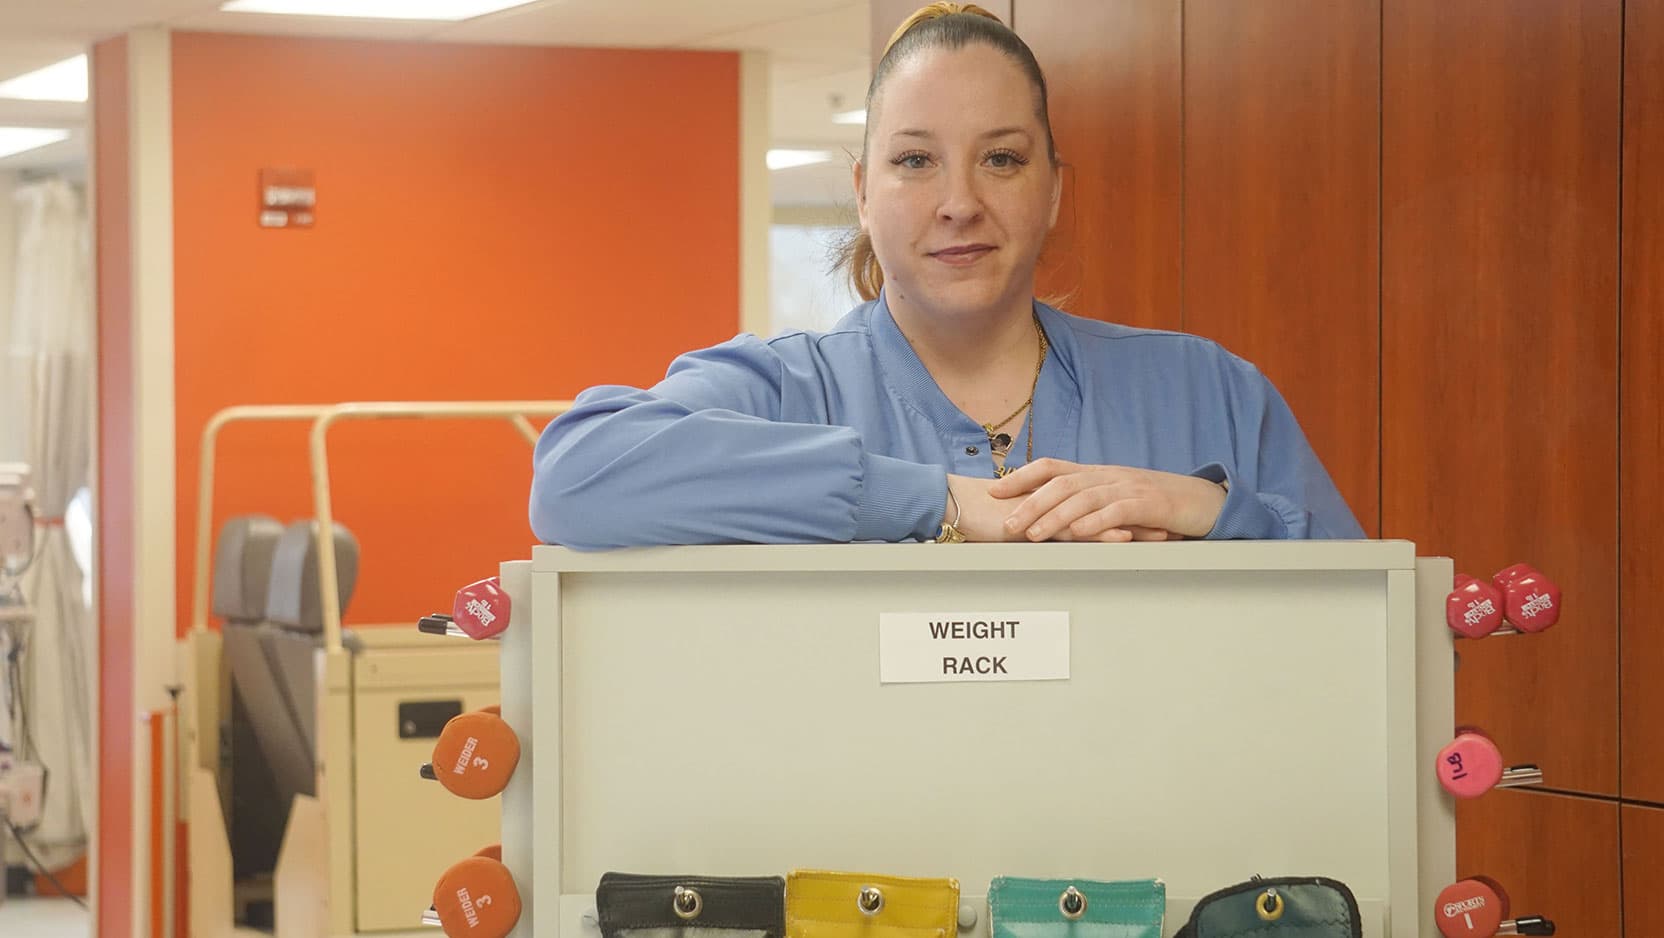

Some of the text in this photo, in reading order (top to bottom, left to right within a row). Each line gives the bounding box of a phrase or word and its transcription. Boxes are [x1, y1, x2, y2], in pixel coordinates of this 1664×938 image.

[929, 621, 1020, 639] WEIGHT
[943, 656, 1008, 674] RACK
[453, 736, 479, 775] WEIDER
[473, 756, 489, 771] 3
[456, 887, 480, 928] WEIDER
[475, 894, 492, 909] 3
[1463, 913, 1474, 930] 1
